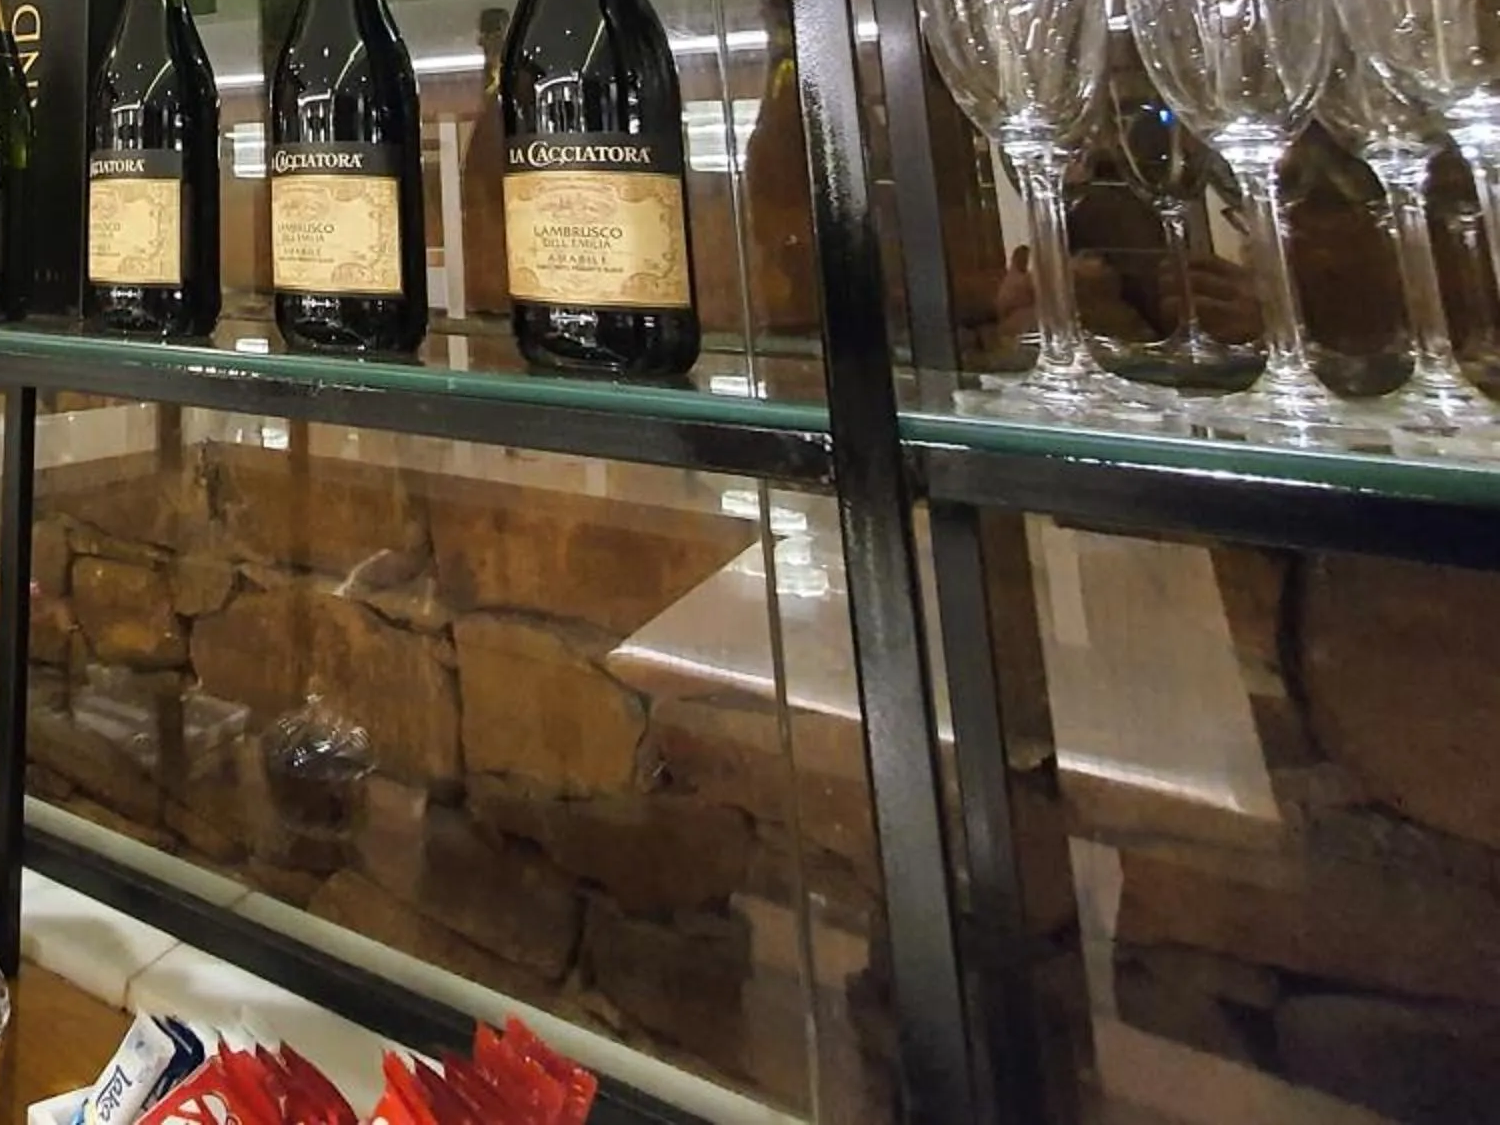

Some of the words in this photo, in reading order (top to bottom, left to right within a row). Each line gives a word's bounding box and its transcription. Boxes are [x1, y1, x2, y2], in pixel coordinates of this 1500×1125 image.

[510, 148, 525, 164] LA
[527, 140, 651, 168] CACCIATORA
[533, 225, 623, 240] LAMBRUSCO
